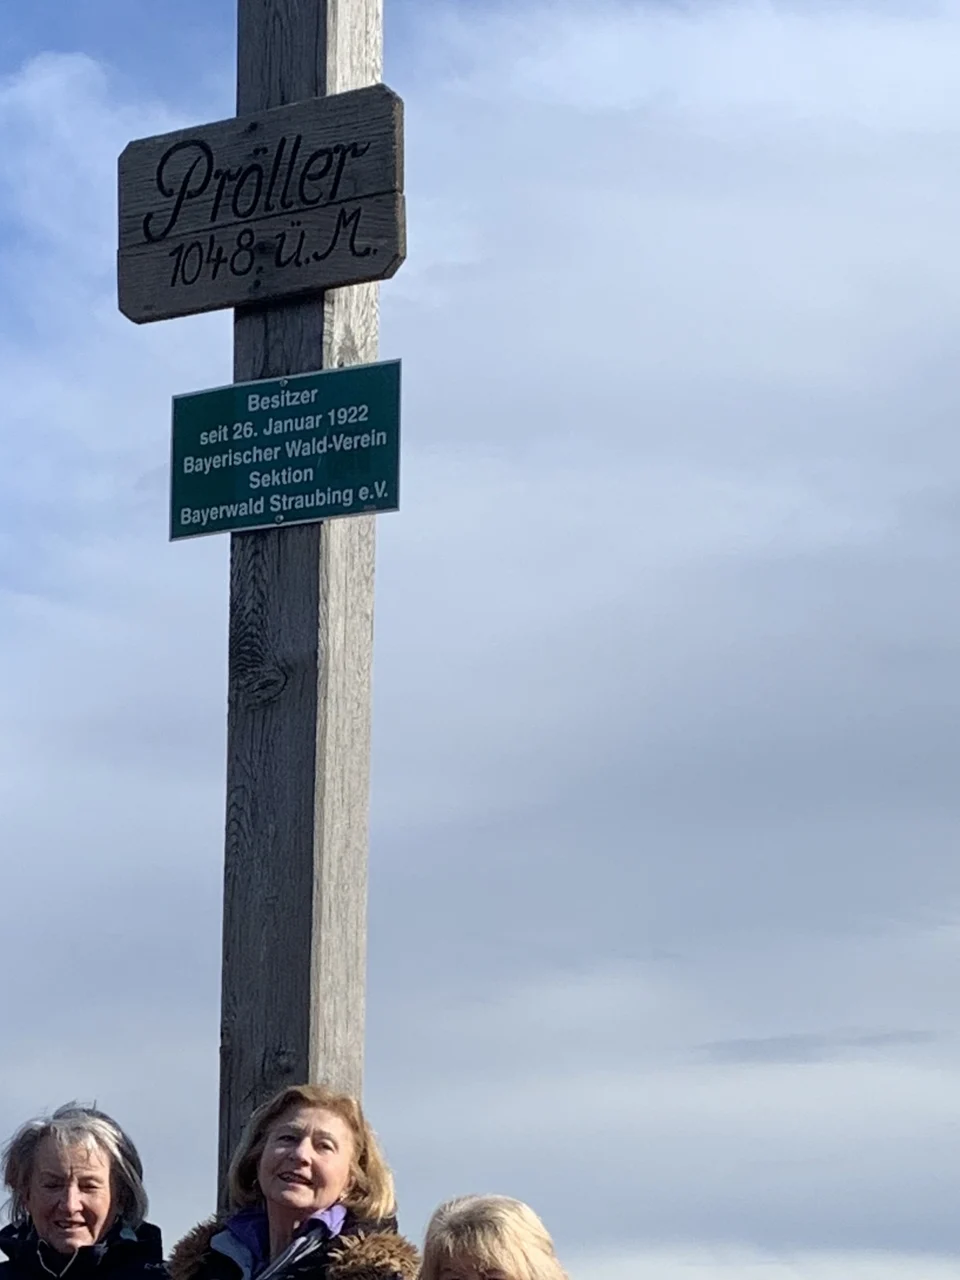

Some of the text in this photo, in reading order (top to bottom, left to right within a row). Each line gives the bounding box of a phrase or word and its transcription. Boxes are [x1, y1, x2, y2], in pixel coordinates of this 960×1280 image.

[143, 135, 371, 243] Pröller
[247, 387, 319, 413] Besitzer
[199, 403, 369, 446] seit 26. Januar 1922
[183, 429, 387, 475] Bayerischer Wald-Verein
[248, 466, 314, 490] Sektion
[180, 480, 389, 527] Bayerwald Straubing e.V.
